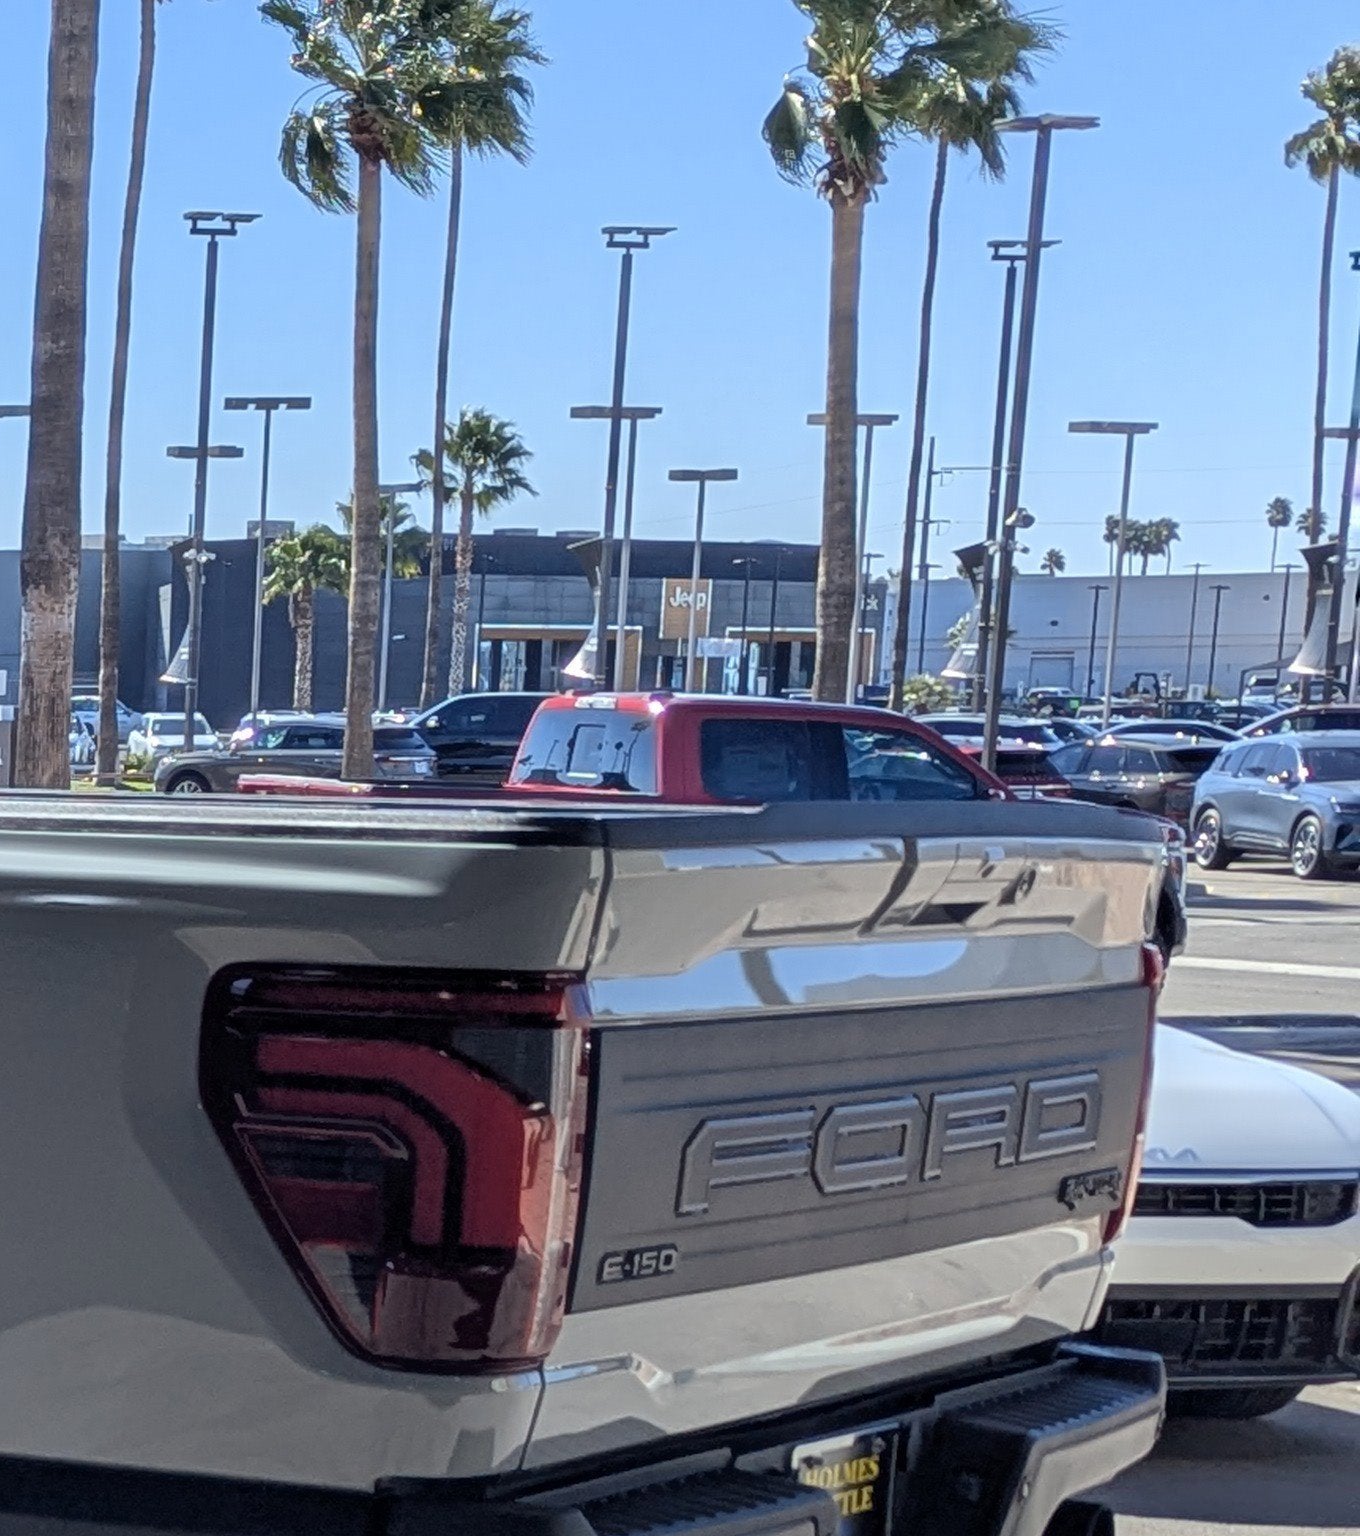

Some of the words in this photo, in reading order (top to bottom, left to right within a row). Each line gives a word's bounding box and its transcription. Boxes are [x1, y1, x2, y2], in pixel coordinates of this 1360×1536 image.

[669, 585, 707, 610] Jeep
[676, 1069, 1099, 1217] FORD
[804, 1456, 880, 1489] HOLMES
[833, 1483, 875, 1517] TLE
